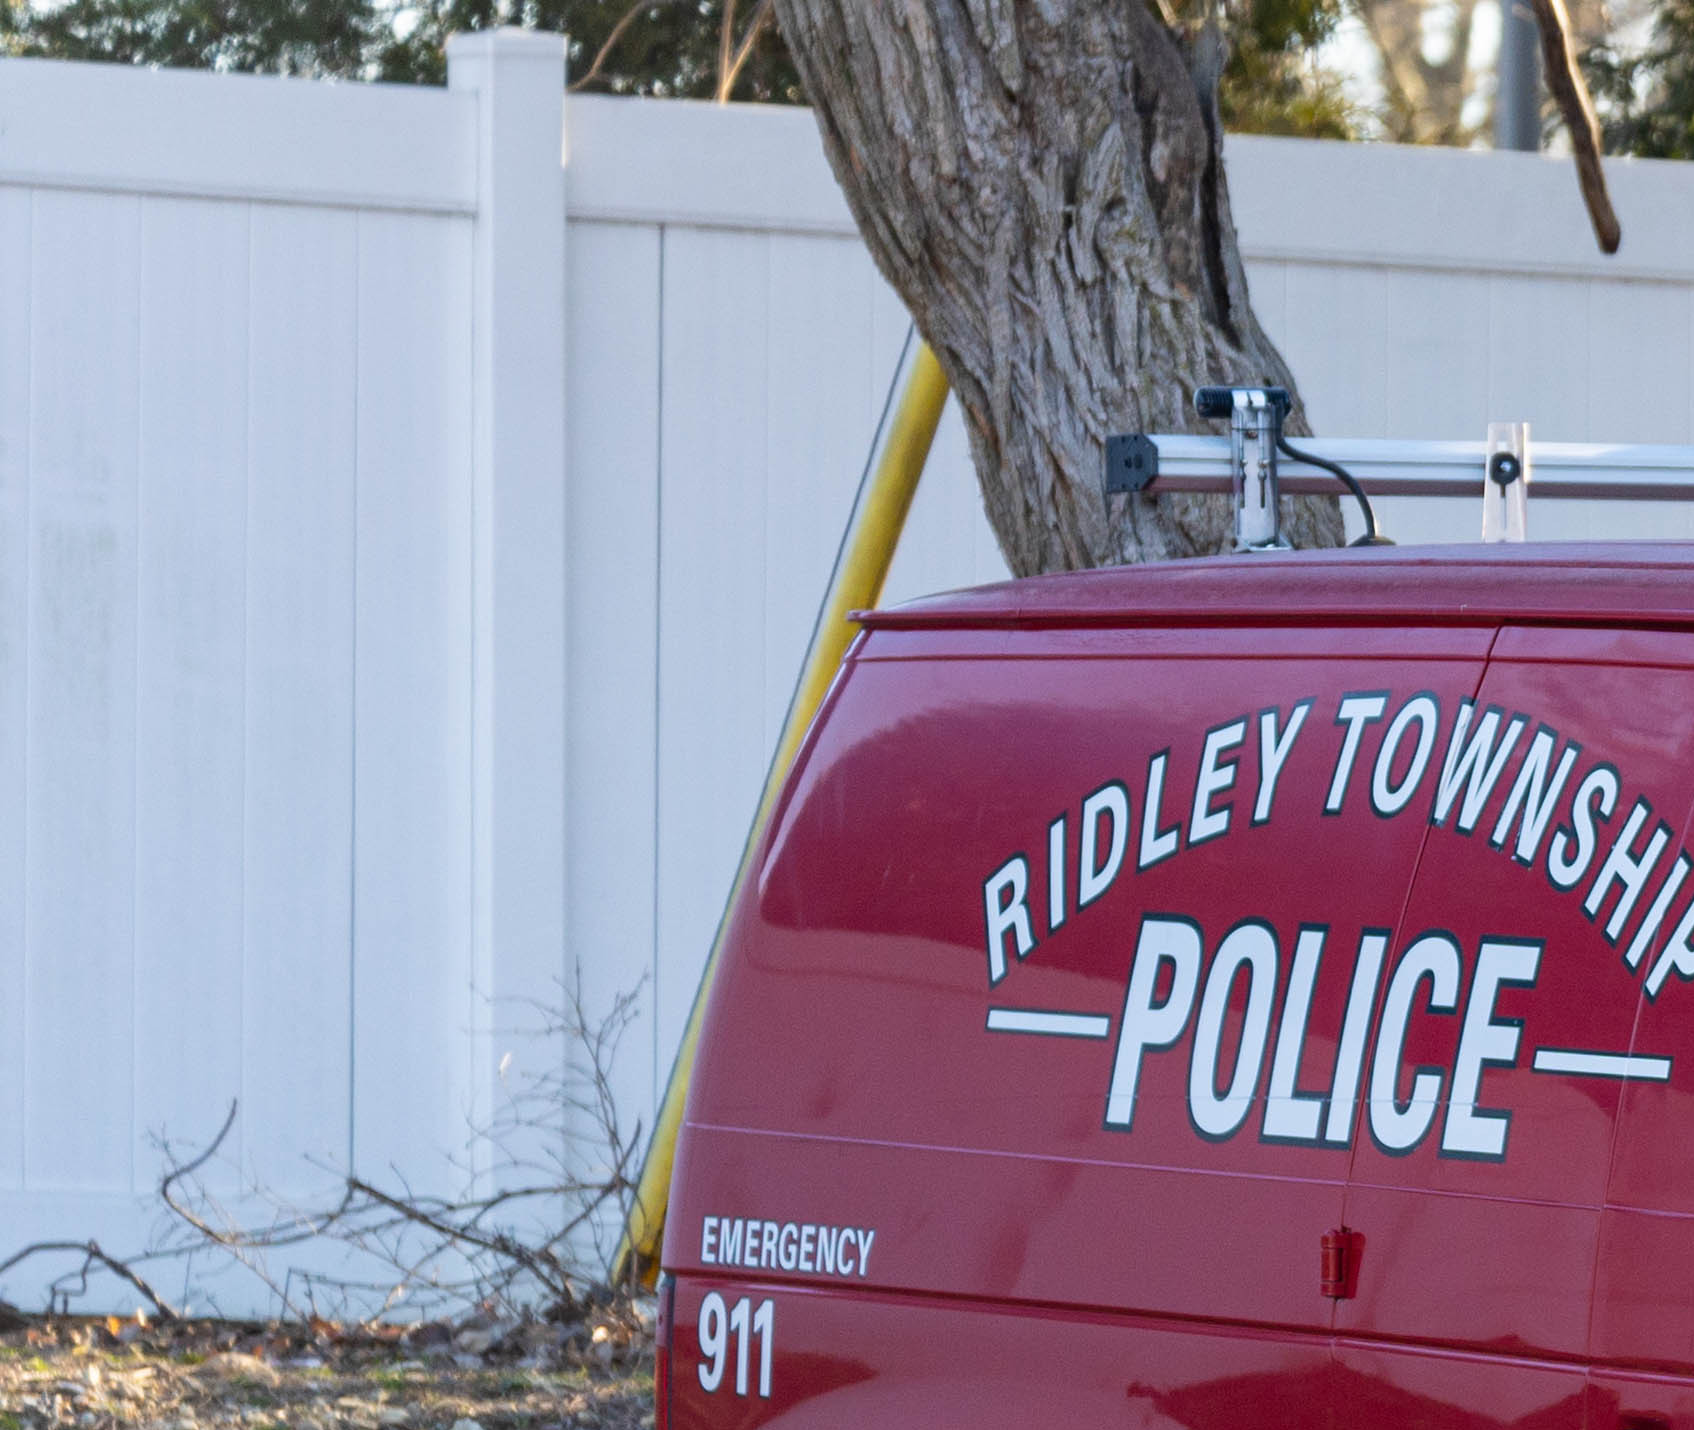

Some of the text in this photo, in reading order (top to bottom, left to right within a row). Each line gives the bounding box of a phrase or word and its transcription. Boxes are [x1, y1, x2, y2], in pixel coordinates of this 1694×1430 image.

[984, 695, 1313, 987] RIDLEY
[1102, 914, 1544, 1161] POLICE
[700, 1215, 875, 1277] EMERGENCY
[697, 1291, 775, 1399] 911
